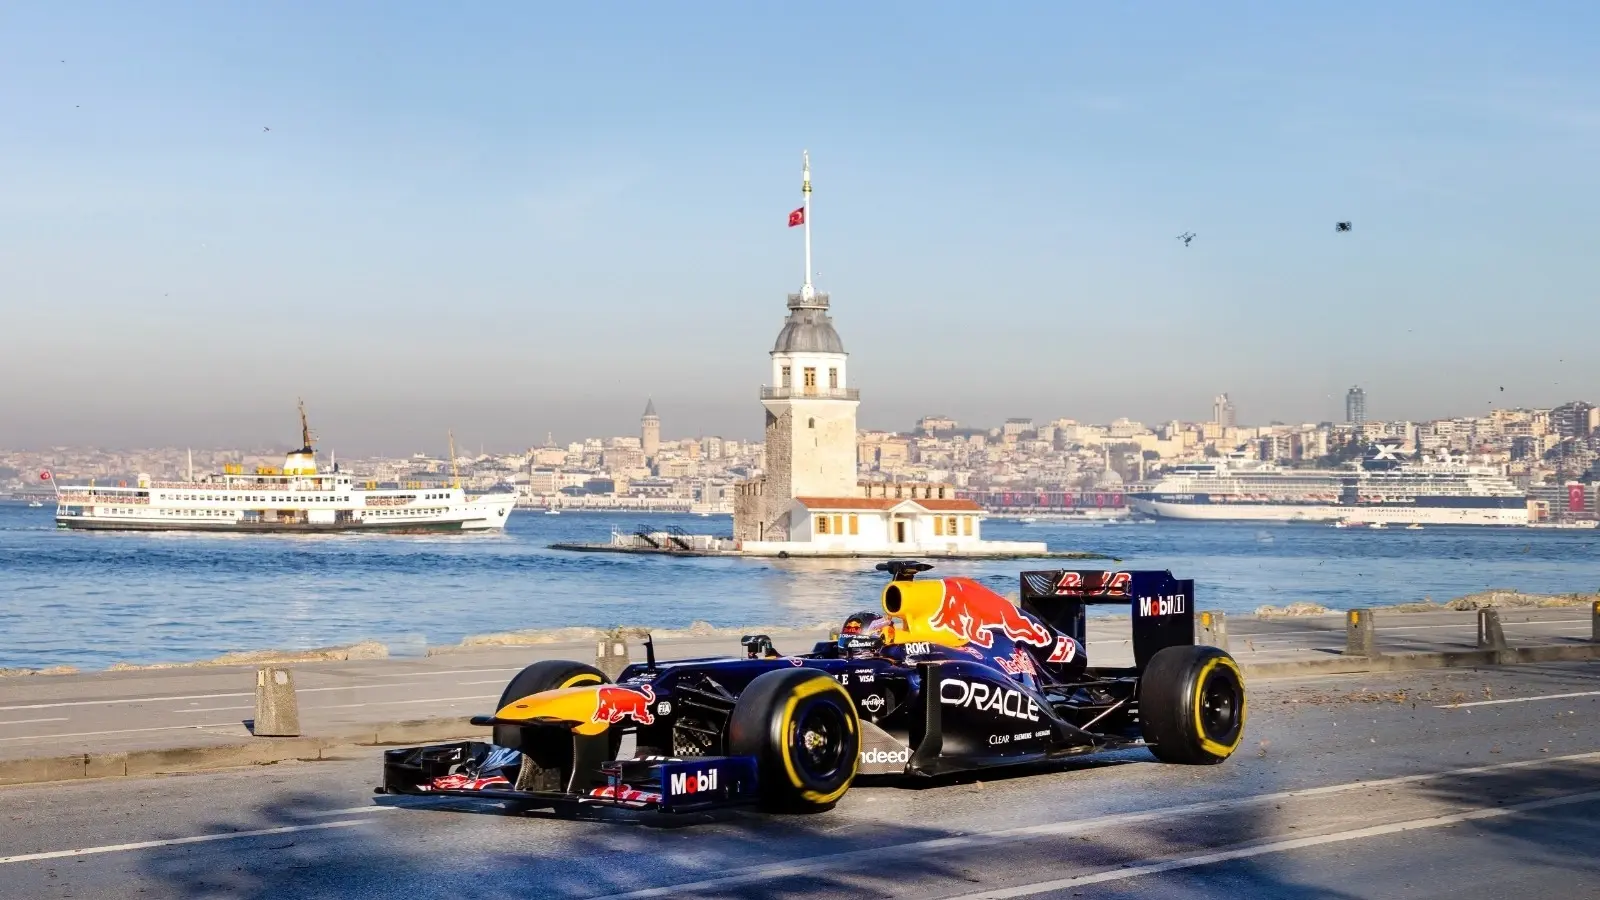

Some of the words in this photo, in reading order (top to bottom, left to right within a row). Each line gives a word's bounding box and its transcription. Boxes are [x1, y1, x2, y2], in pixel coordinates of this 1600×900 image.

[1140, 595, 1174, 616] Mobil
[905, 642, 930, 655] ROKT
[940, 678, 1040, 722] ORACLE
[989, 735, 1010, 745] CLEAR
[1013, 732, 1032, 741] SIEMENS
[671, 768, 718, 795] Mobil
